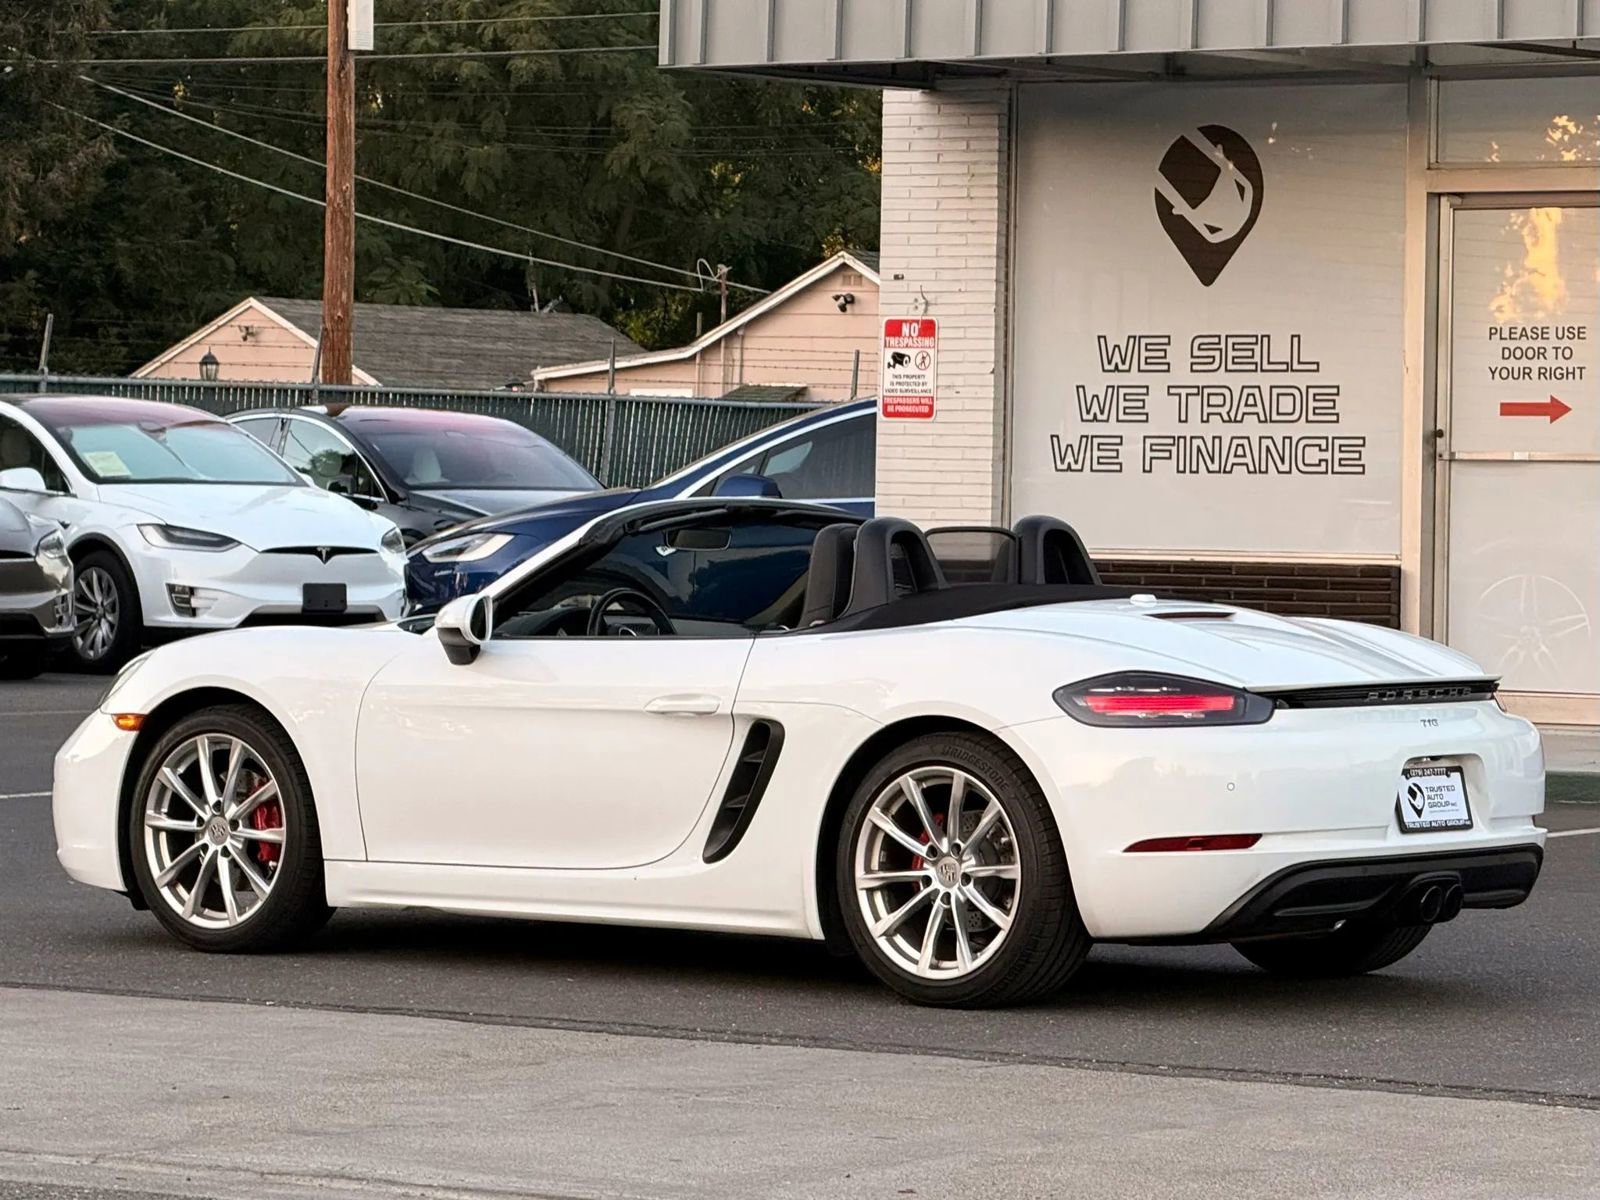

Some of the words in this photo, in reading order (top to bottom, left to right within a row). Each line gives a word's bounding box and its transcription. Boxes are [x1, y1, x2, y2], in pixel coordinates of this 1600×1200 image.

[902, 322, 919, 337] NO
[1489, 326, 1550, 340] PLEASE
[1555, 326, 1586, 340] USE
[885, 337, 935, 348] TRESPASSING
[1097, 335, 1170, 372] WE
[1190, 335, 1320, 372] SELL
[1501, 346, 1547, 360] DOOR
[1552, 346, 1573, 360] TO
[1488, 366, 1533, 380] YOUR
[1538, 366, 1586, 380] RIGHT
[1076, 385, 1149, 423] WE
[1167, 385, 1340, 423] TRADE
[1050, 434, 1123, 473] WE
[1142, 436, 1366, 474] FINANCE
[1364, 687, 1472, 702] PORSCHE
[942, 745, 1009, 792] BRIDGESTONE
[1425, 785, 1455, 793] TRUSTED
[1406, 821, 1430, 829] TRUSTED
